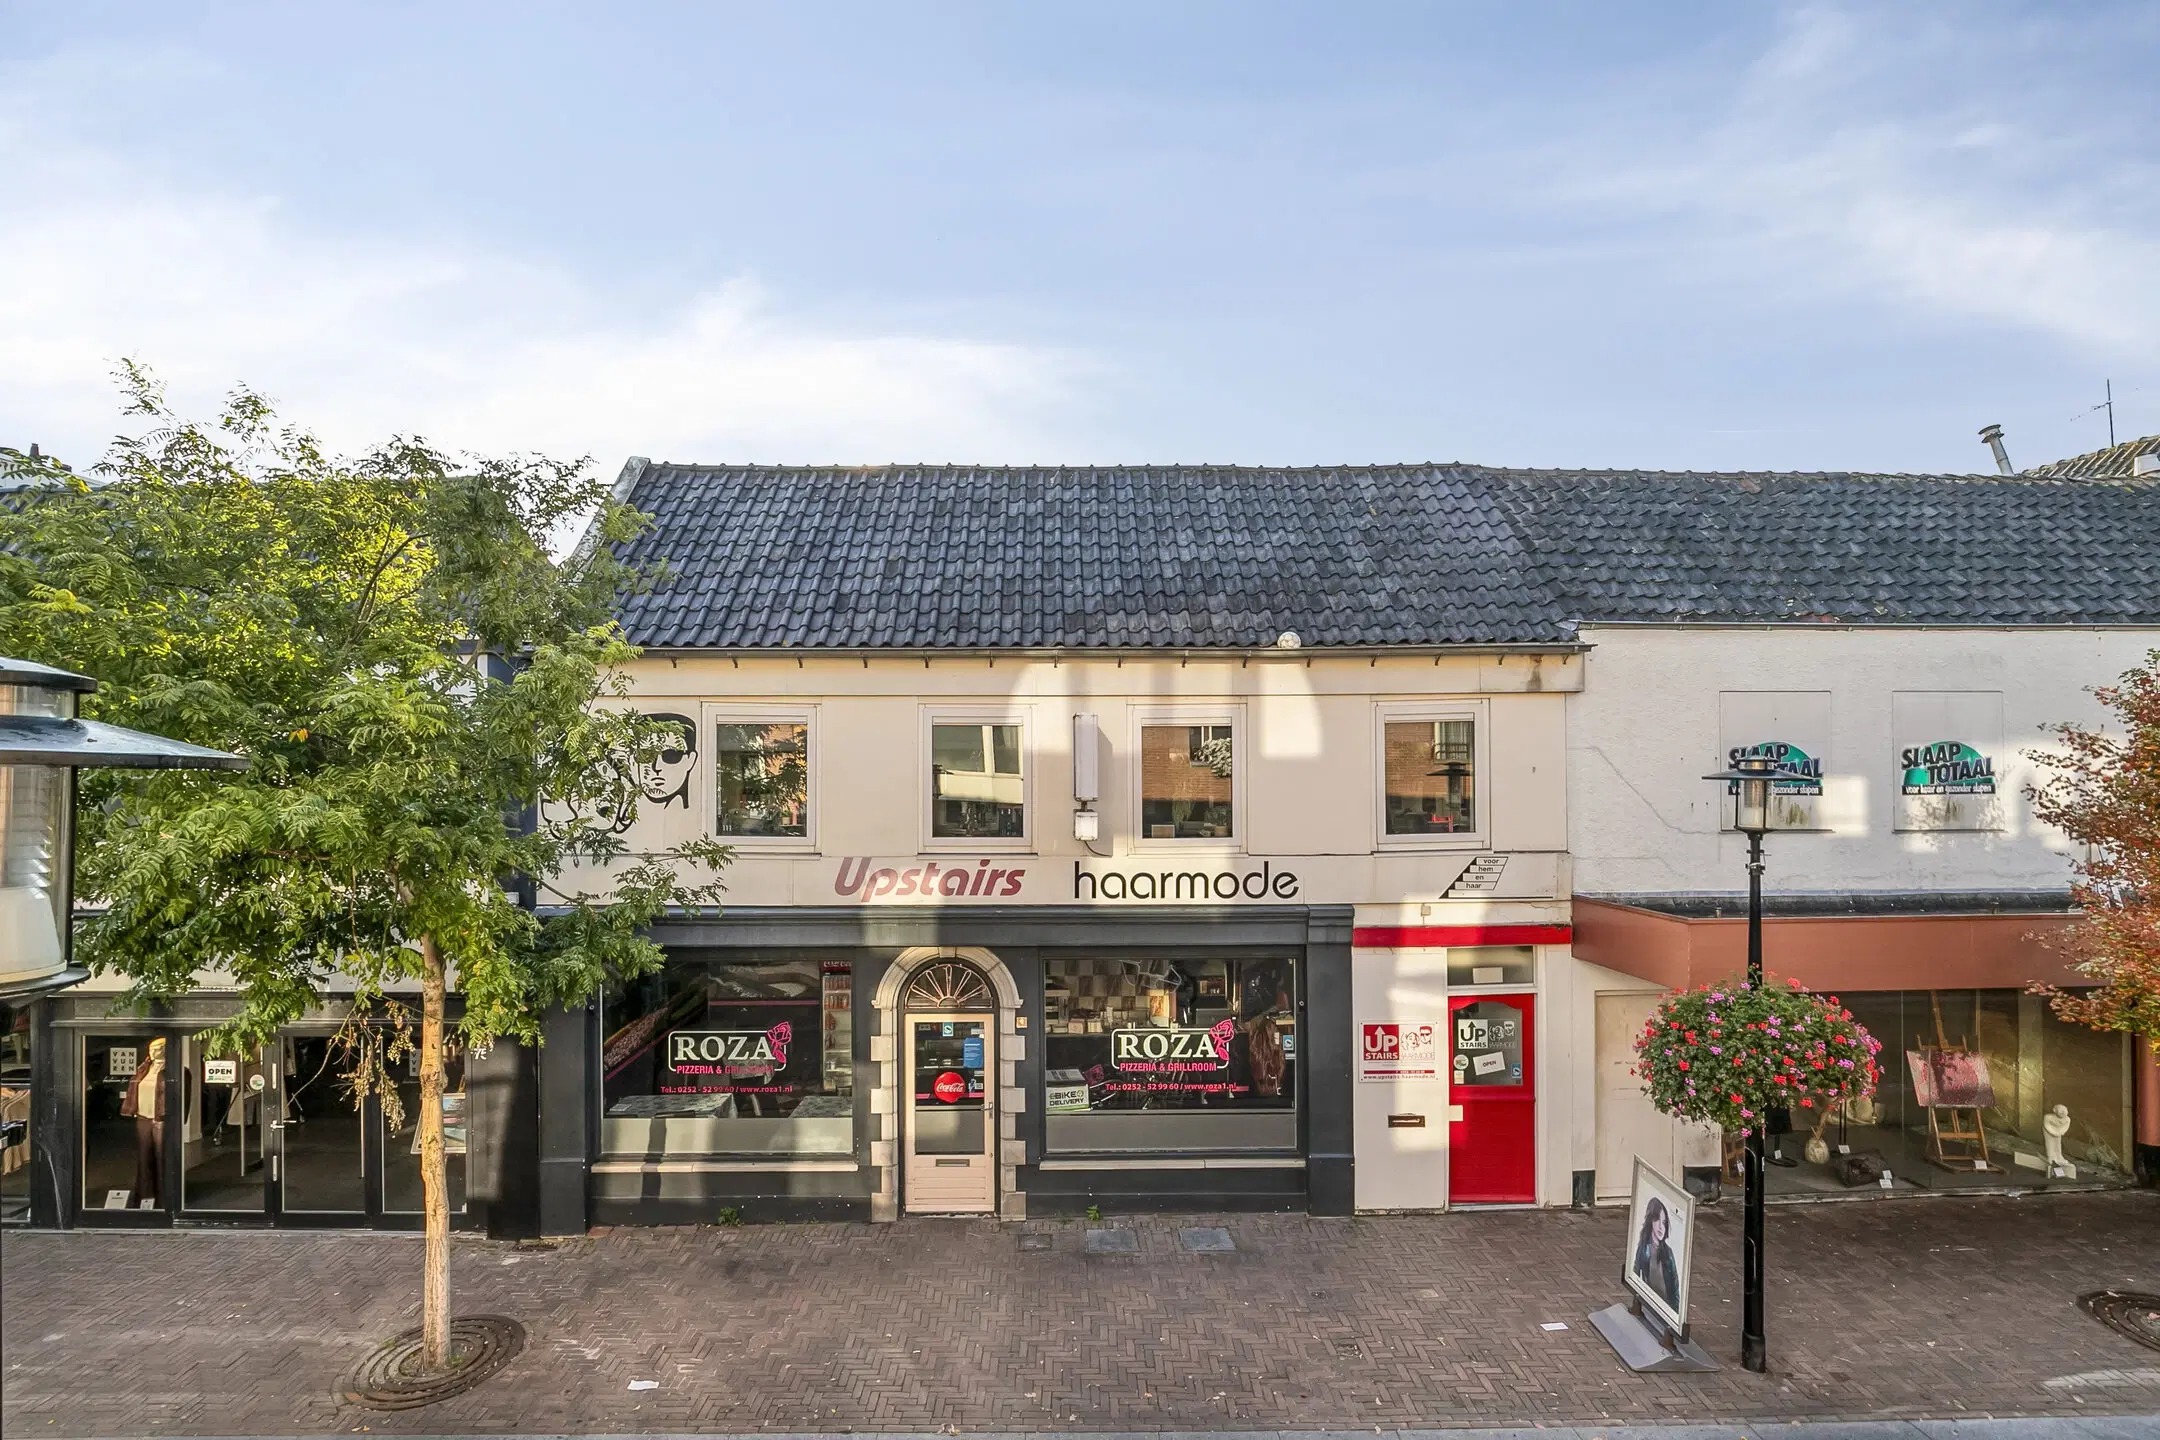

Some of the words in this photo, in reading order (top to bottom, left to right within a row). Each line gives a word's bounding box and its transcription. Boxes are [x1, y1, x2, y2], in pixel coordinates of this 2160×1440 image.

[1901, 743, 1960, 770] SLAAP
[1926, 757, 1995, 784] TOTAAL
[834, 856, 1026, 903] Upstairs
[1074, 861, 1300, 899] haarmode
[1365, 1029, 1398, 1052] UP
[1460, 1024, 1487, 1041] UP
[674, 1036, 776, 1061] ROZA
[1117, 1034, 1219, 1059] ROZA
[1365, 1052, 1398, 1060] STAIRS
[676, 1065, 713, 1074] PIZZERIA
[716, 1065, 722, 1074] &
[1120, 1063, 1157, 1072] PIZZERIA
[1159, 1063, 1165, 1072] &
[1167, 1062, 1217, 1072] GRILLROOM
[1168, 1083, 1179, 1091] 60
[1050, 1098, 1084, 1106] DELIVERY
